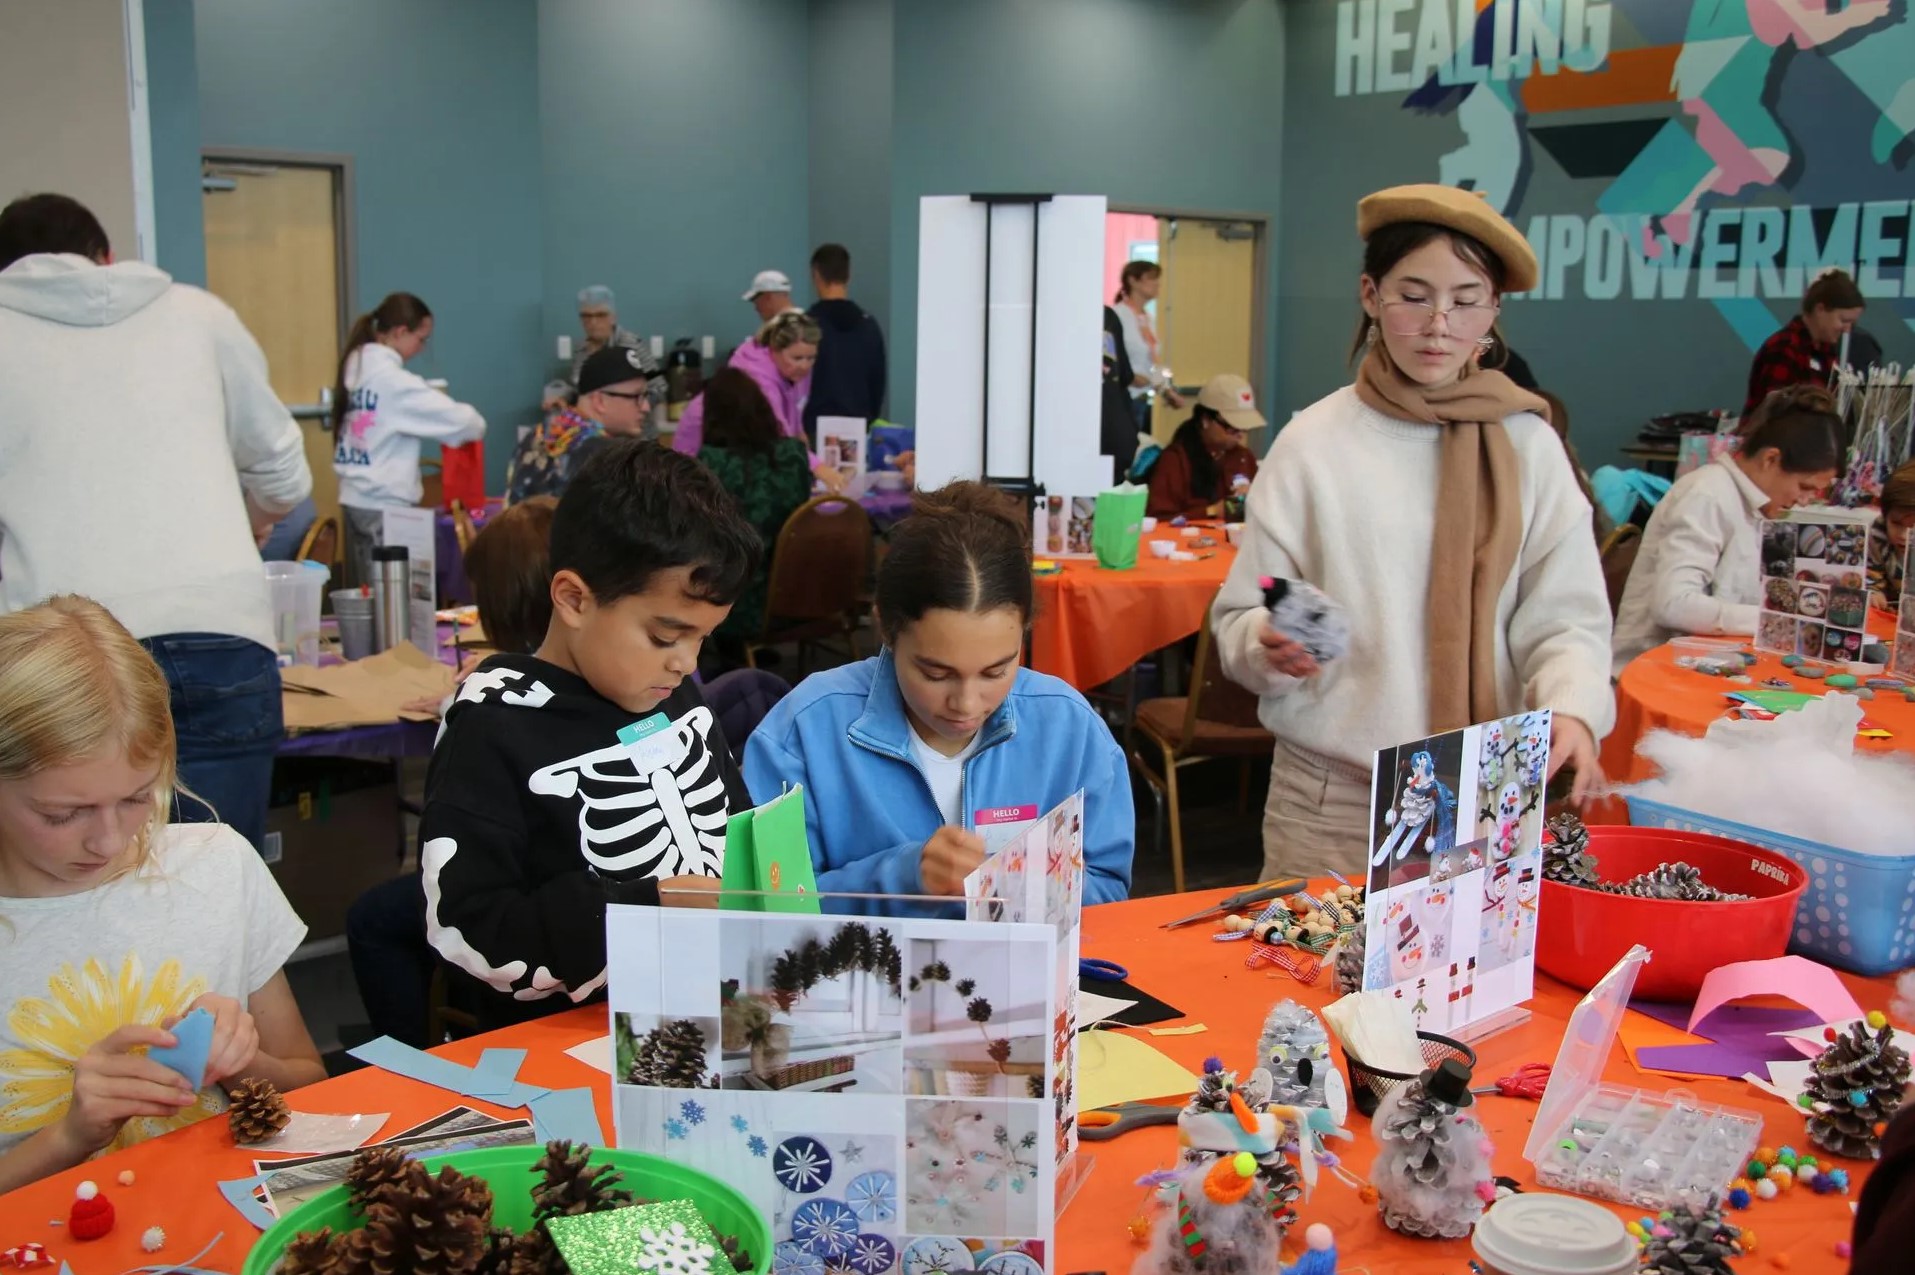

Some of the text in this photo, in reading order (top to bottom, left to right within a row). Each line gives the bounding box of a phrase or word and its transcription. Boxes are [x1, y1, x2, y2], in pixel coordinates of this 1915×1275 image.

[1335, 0, 1612, 97] HEALING
[1501, 199, 1915, 300] POWERME
[633, 720, 655, 733] HELLO
[992, 808, 1020, 818] HELLO
